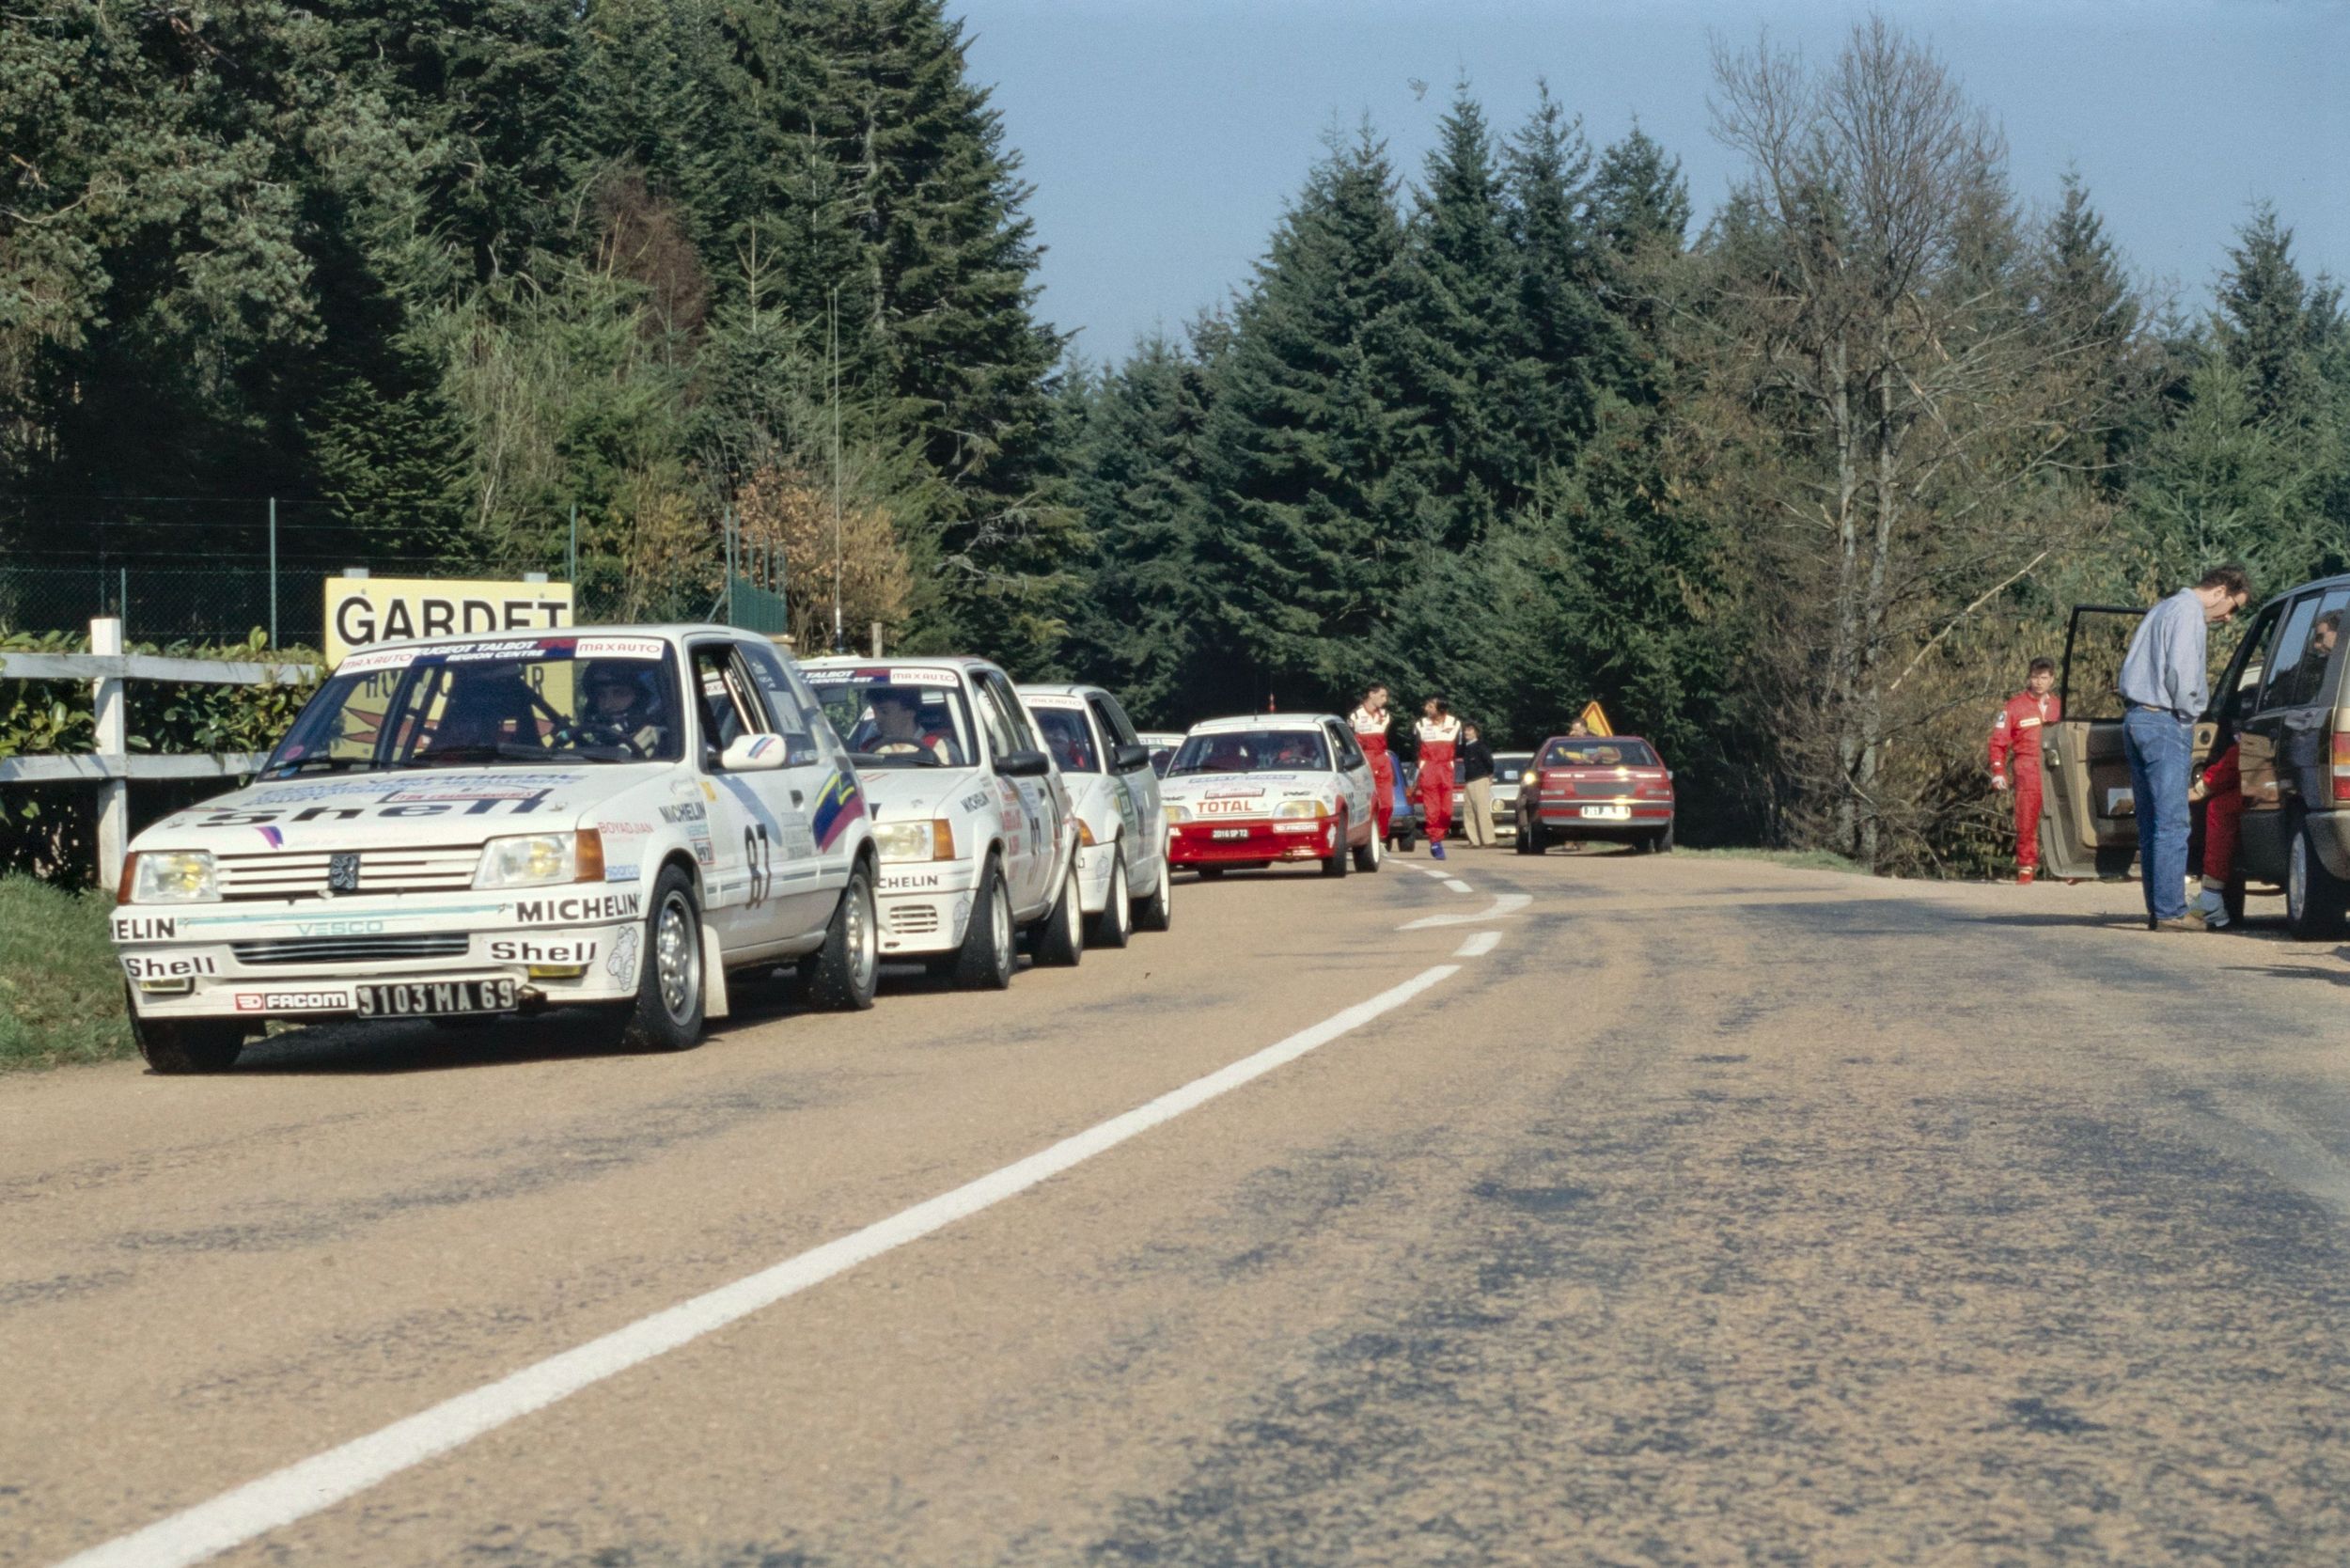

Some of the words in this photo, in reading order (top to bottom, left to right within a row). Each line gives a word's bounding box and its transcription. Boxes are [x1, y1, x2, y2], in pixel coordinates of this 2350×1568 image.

[337, 596, 568, 646] GARDET
[477, 640, 539, 653] TALBOT
[578, 642, 661, 654] MAXAUTO
[341, 653, 414, 670] MAXAUTO
[446, 651, 494, 662] REGION
[495, 649, 546, 659] CENTRE
[806, 670, 854, 679] TALBOT
[892, 672, 956, 682] MAXAUTO
[196, 798, 544, 827] Shell
[658, 800, 707, 823] MICHELIN
[1197, 800, 1253, 813] TOTAL
[517, 893, 639, 922] MICHELIN
[295, 919, 384, 937] VESCO
[491, 941, 597, 962] Shell
[125, 956, 216, 978] Shell
[267, 993, 348, 1009] FACOM
[359, 984, 429, 1015] 9103
[433, 983, 471, 1011] MA
[480, 979, 515, 1010] 69
